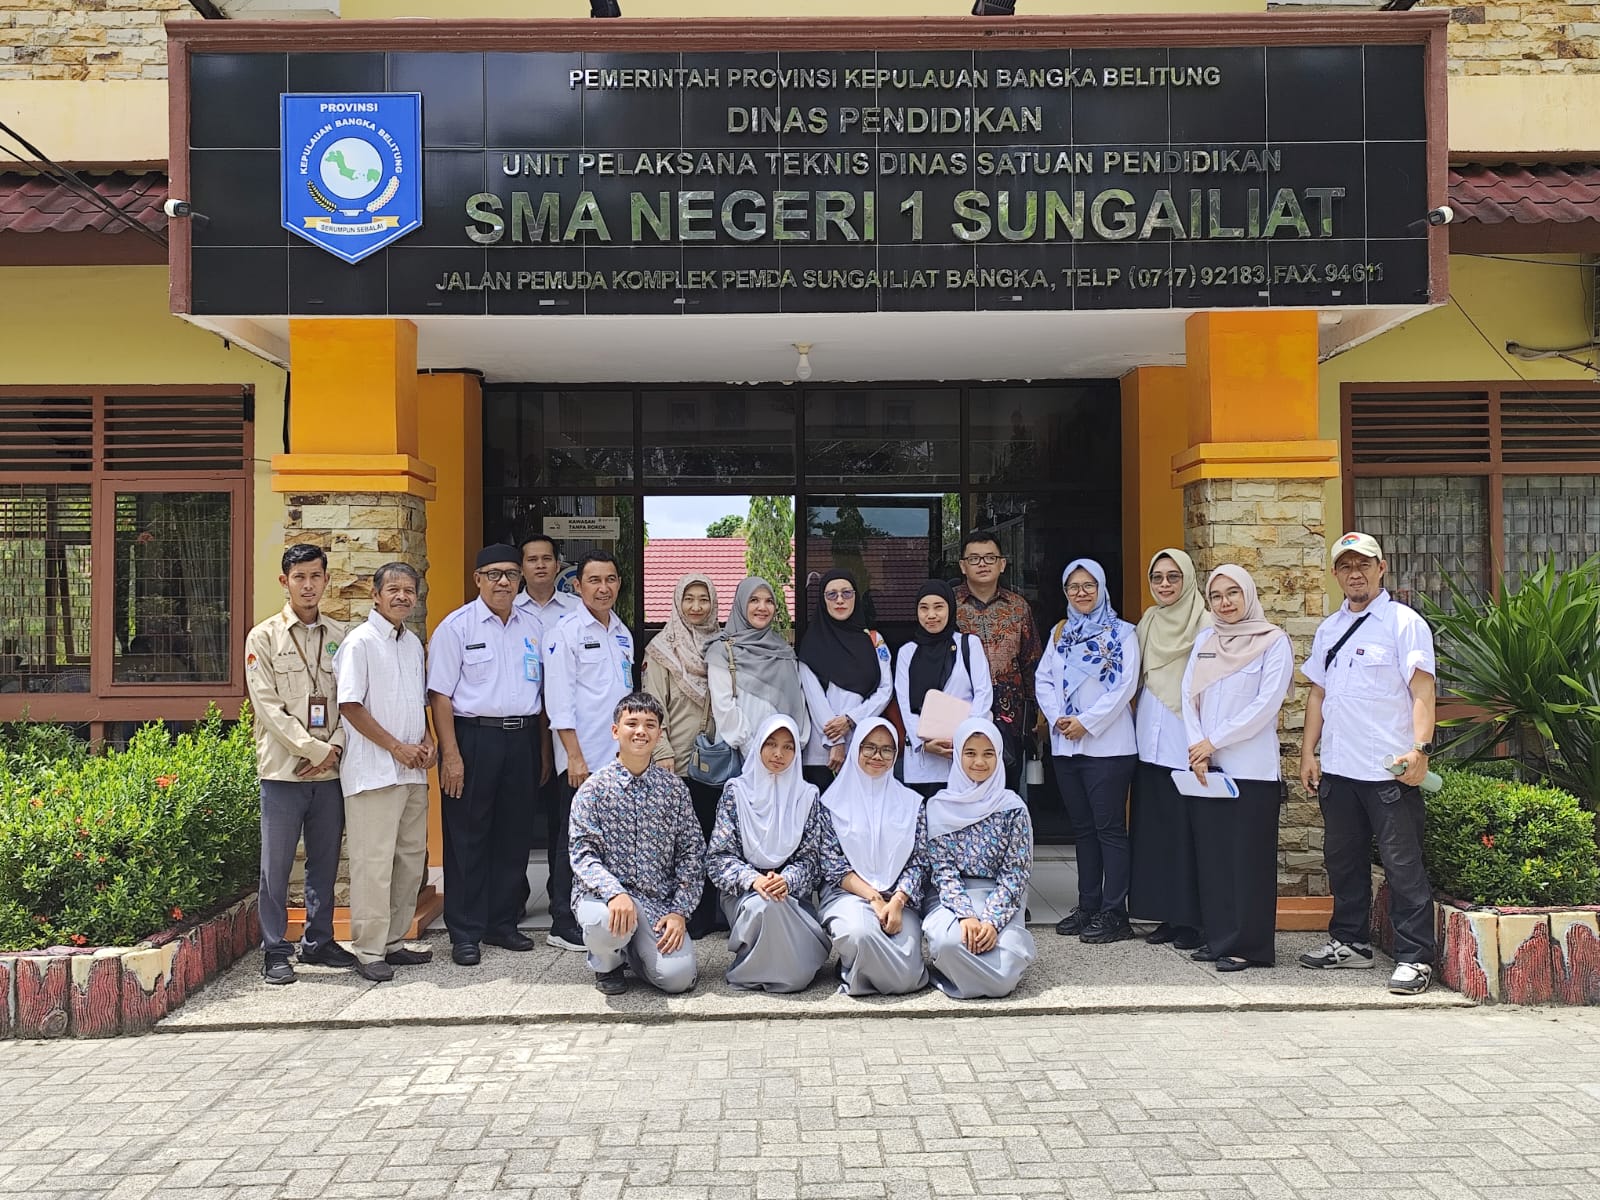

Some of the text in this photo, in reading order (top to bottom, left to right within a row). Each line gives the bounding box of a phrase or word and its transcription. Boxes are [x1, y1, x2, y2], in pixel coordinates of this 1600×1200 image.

[569, 66, 1222, 89] PEMERINTAH PROVINSI KEPULAUAN BANGKA BELITUNG
[320, 103, 378, 113] PROVINSI
[727, 106, 1043, 135] DINAS PENDIDIKAN
[300, 117, 403, 175] KEPULAUAN BANGKA BELITUNG
[502, 150, 1281, 176] UNIT PELAKSANA TEKNIS DINAS SATUAN PENDIDIKAN
[320, 223, 384, 234] SERUMPUN SEBALAI
[464, 186, 1347, 244] SMA NEGERI 1 SUNGAILIAT
[435, 271, 512, 291] JALAN
[517, 271, 608, 291] PEMUDA
[611, 270, 719, 290] KOMPLEK
[721, 269, 797, 290] PEMDA
[802, 268, 940, 290] SUNGAILIAT
[946, 268, 1057, 292] BANGKA,
[1062, 267, 1122, 288] TELP
[1325, 262, 1385, 283] 94611
